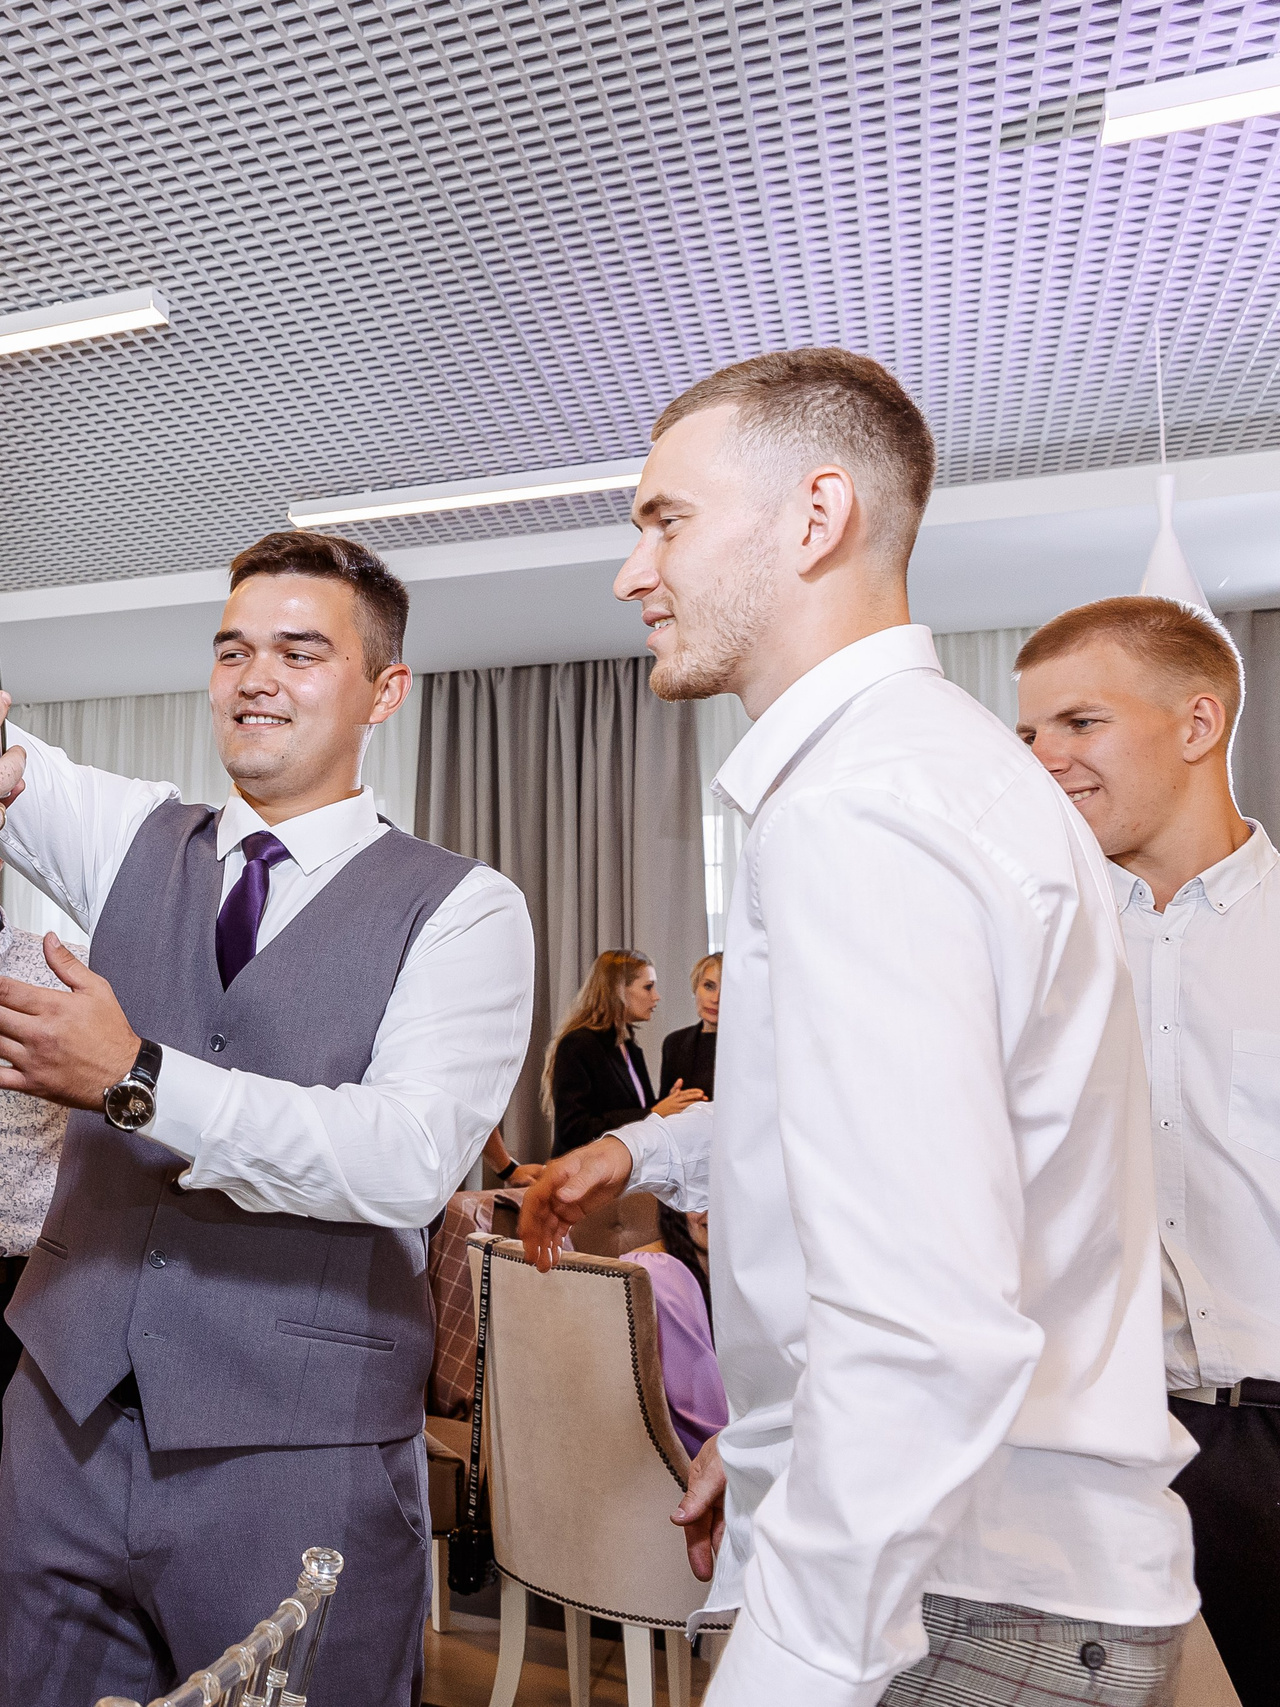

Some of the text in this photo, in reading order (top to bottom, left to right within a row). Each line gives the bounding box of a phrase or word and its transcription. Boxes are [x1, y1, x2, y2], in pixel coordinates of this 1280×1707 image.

[478, 1254, 490, 1348] FOREVER BETTER
[472, 1358, 484, 1454] FOREVER BETTER
[469, 1463, 478, 1506] BETTER
